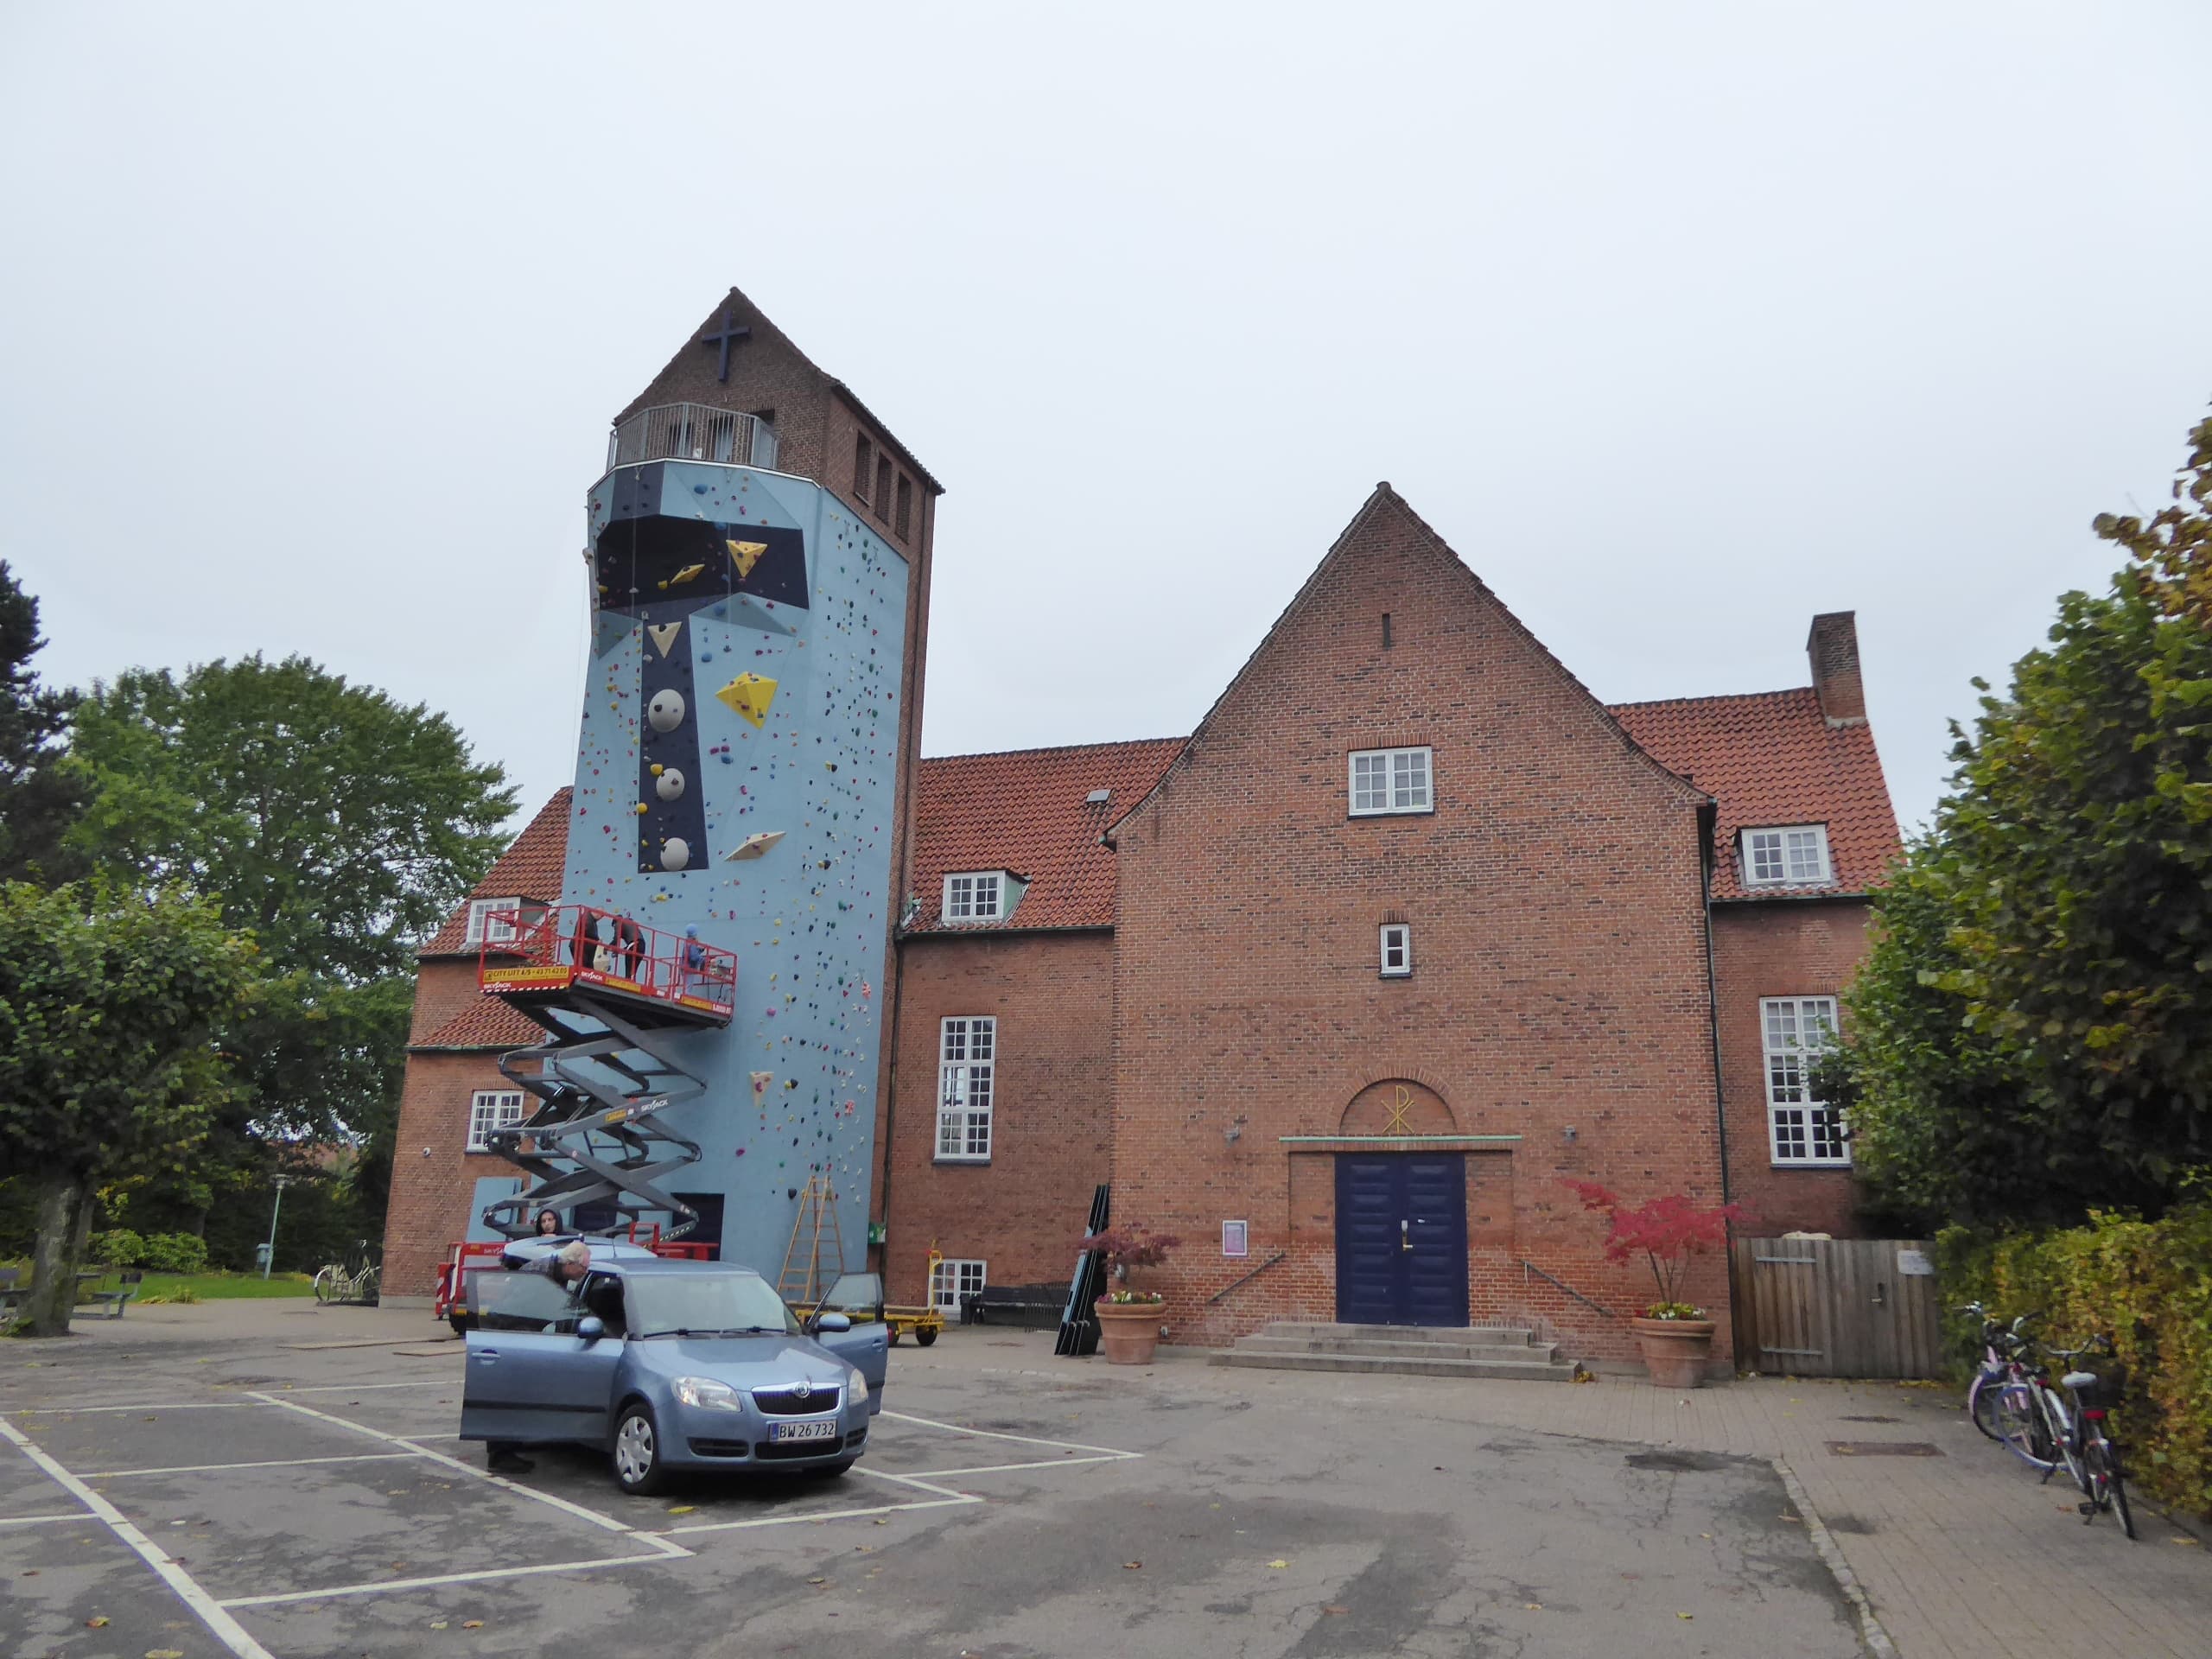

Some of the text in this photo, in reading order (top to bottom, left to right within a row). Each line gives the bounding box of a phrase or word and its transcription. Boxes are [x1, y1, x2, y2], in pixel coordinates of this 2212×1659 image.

[581, 971, 603, 981] SKYJACK
[641, 1099, 668, 1112] SKYJACK
[779, 1422, 835, 1438] BW 26 732
